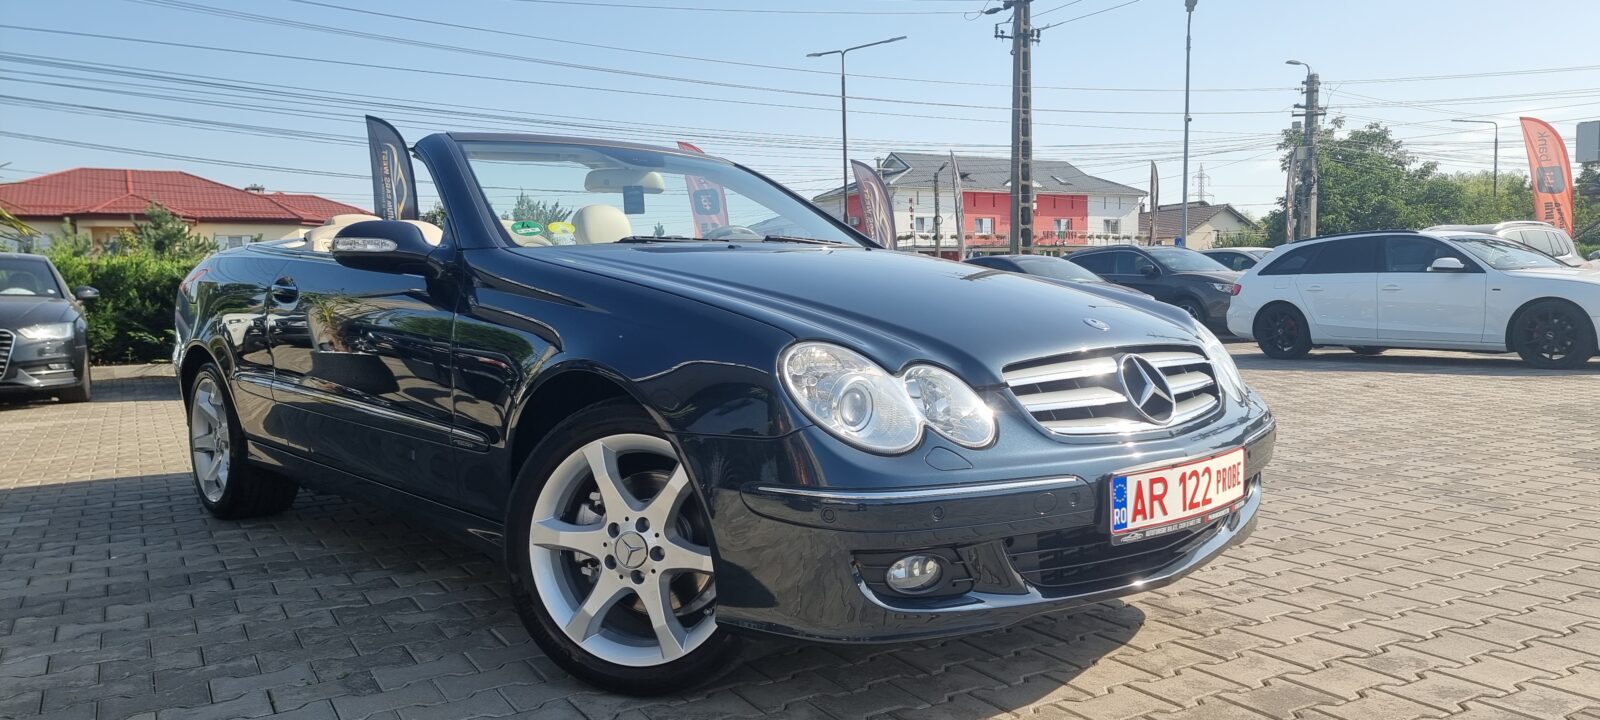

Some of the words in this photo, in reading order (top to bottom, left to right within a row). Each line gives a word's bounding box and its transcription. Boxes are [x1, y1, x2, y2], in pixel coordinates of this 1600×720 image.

[1131, 476, 1168, 523] AR
[1179, 466, 1212, 512] 122
[1216, 462, 1242, 494] PROBE
[1114, 507, 1127, 525] RO
